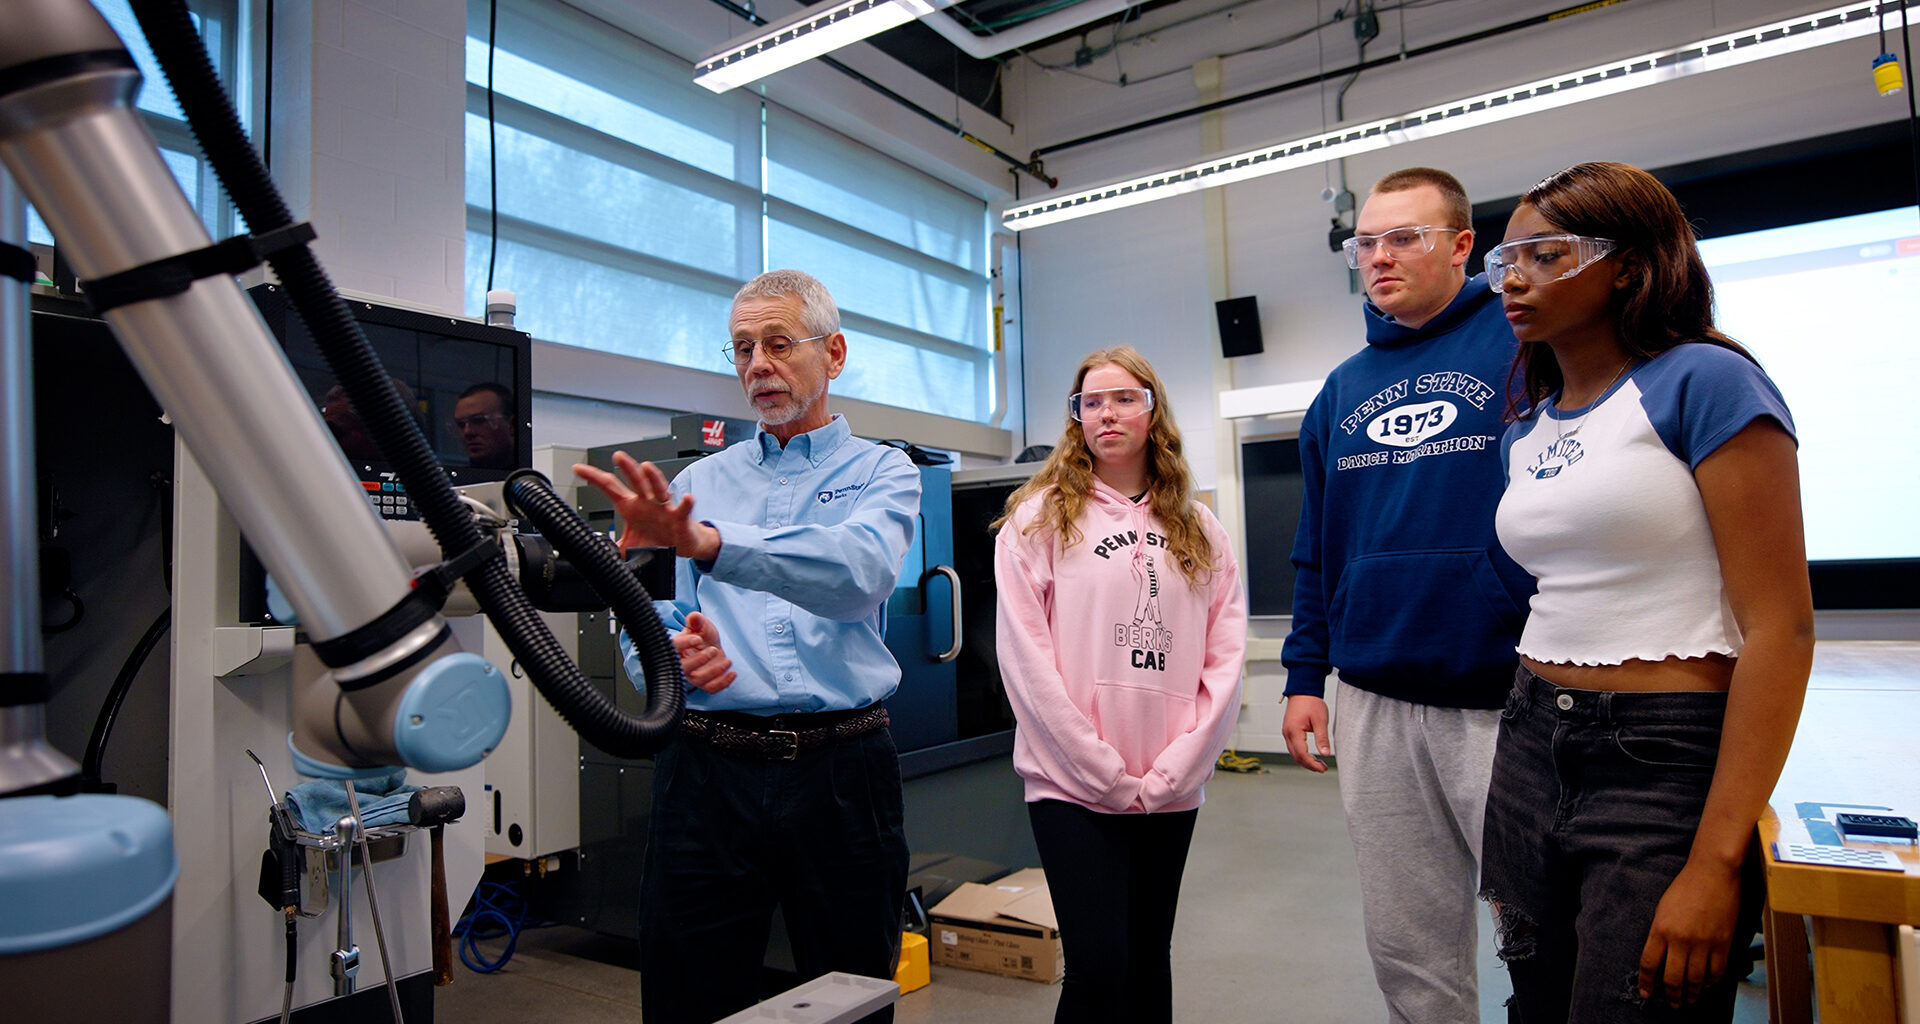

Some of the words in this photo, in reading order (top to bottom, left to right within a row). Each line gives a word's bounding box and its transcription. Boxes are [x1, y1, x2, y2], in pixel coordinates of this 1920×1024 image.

[1340, 379, 1409, 435] PENN
[1414, 371, 1496, 409] STATE
[1379, 405, 1445, 437] 1973
[1337, 451, 1389, 471] DANCE
[1526, 438, 1585, 476] LIMITED
[1093, 530, 1139, 560] PENN
[1145, 531, 1170, 550] ST
[1114, 623, 1173, 653] BERKS
[1131, 648, 1166, 671] CAB
